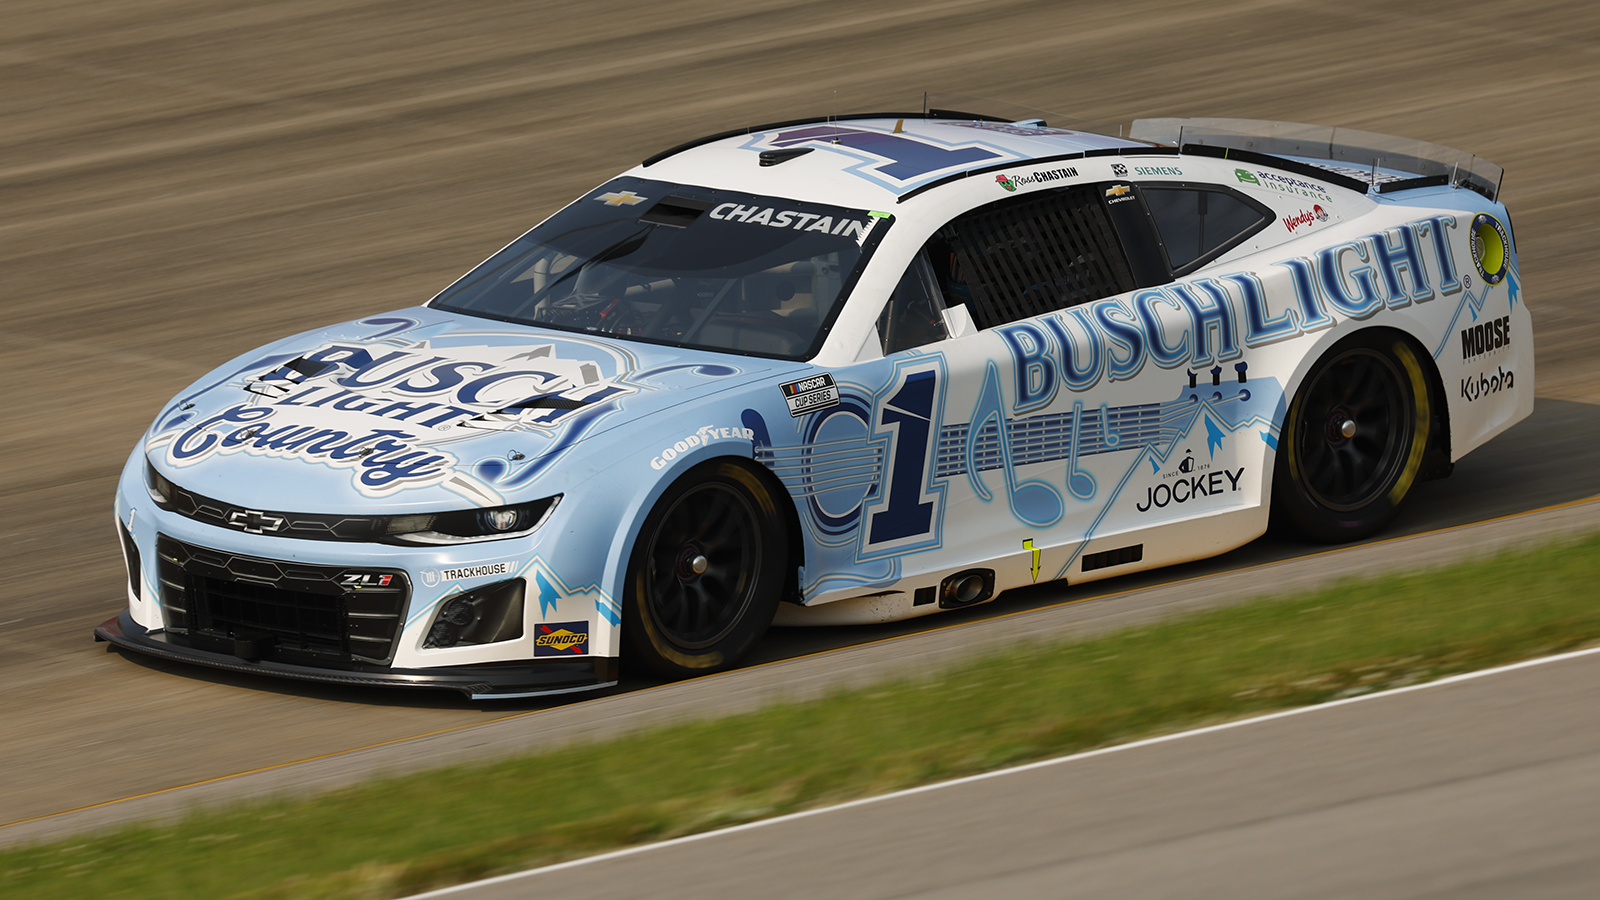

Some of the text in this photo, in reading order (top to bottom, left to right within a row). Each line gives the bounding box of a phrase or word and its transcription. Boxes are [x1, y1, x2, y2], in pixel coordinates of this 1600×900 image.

[1011, 166, 1079, 188] Ross CHASTAIN
[1134, 166, 1183, 176] SIEMENS
[1257, 170, 1327, 194] acceptance
[1107, 195, 1136, 205] CHEVROLET
[1262, 179, 1333, 203] insurance
[709, 202, 866, 240] CHASTAIN
[1282, 209, 1315, 232] Wendy's
[1471, 228, 1485, 278] TRACKHOUSE
[1494, 221, 1510, 270] TRACKHOUSE
[992, 213, 1463, 416] BUSCH LIGHT
[1461, 315, 1510, 359] MOOSE
[257, 345, 629, 424] BUSCH
[798, 376, 827, 393] NASCAR
[1461, 366, 1514, 402] Kubota
[272, 386, 482, 428] LIGHT
[795, 390, 831, 408] CUP SERIES
[172, 404, 446, 486] Country
[863, 361, 942, 553] 1
[1162, 463, 1211, 480] SINCE 1876
[1136, 467, 1245, 512] JOCKEY
[340, 574, 393, 586] ZL1
[444, 563, 506, 580] TRACKHOUSE
[538, 633, 586, 646] SUNOCO
